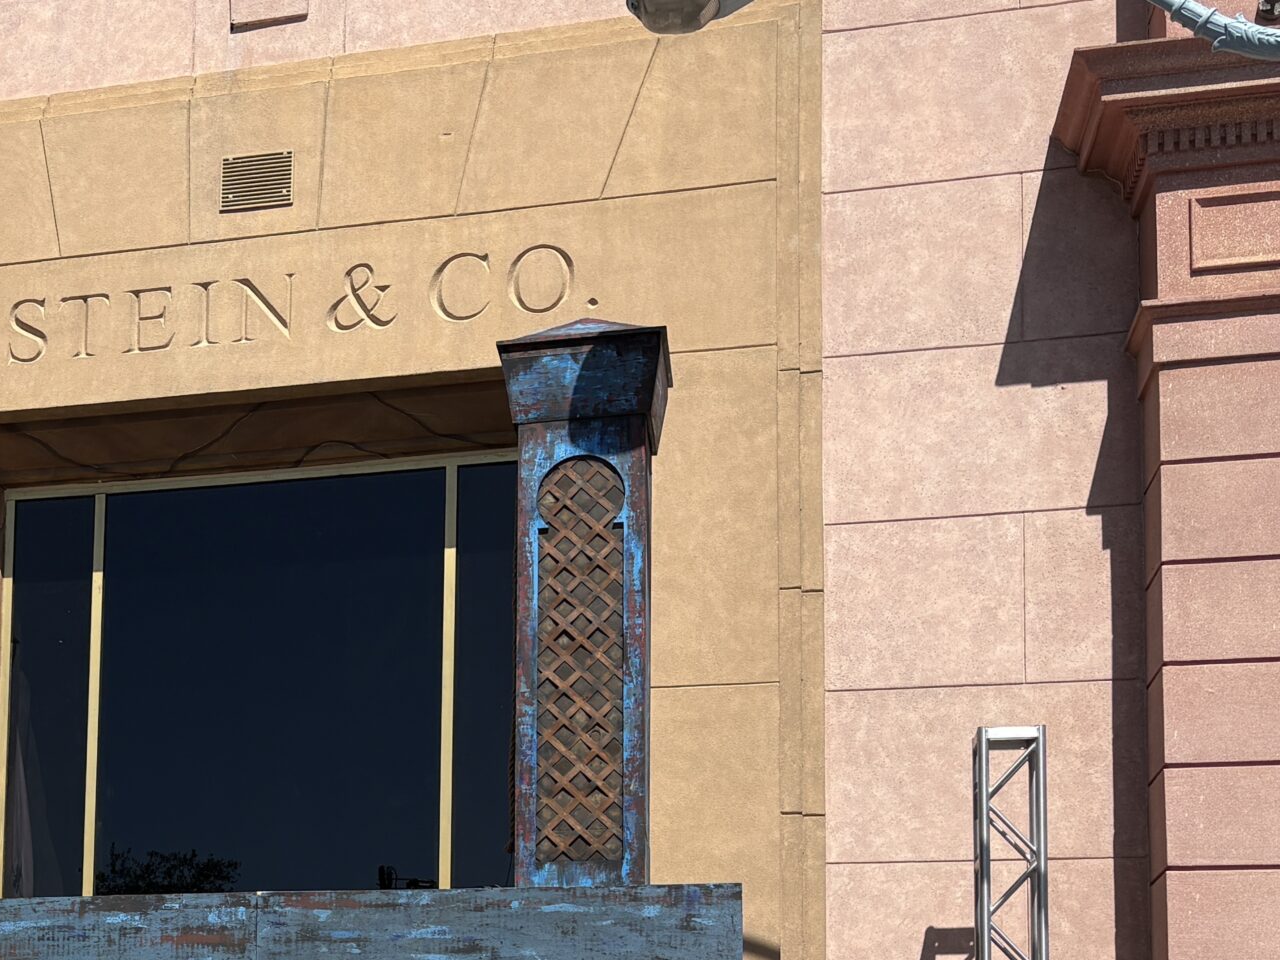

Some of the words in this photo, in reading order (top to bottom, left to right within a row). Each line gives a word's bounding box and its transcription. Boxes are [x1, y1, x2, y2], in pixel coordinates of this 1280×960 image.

[8, 272, 296, 365] STEIN
[326, 262, 399, 333] &
[429, 243, 600, 322] CO.
